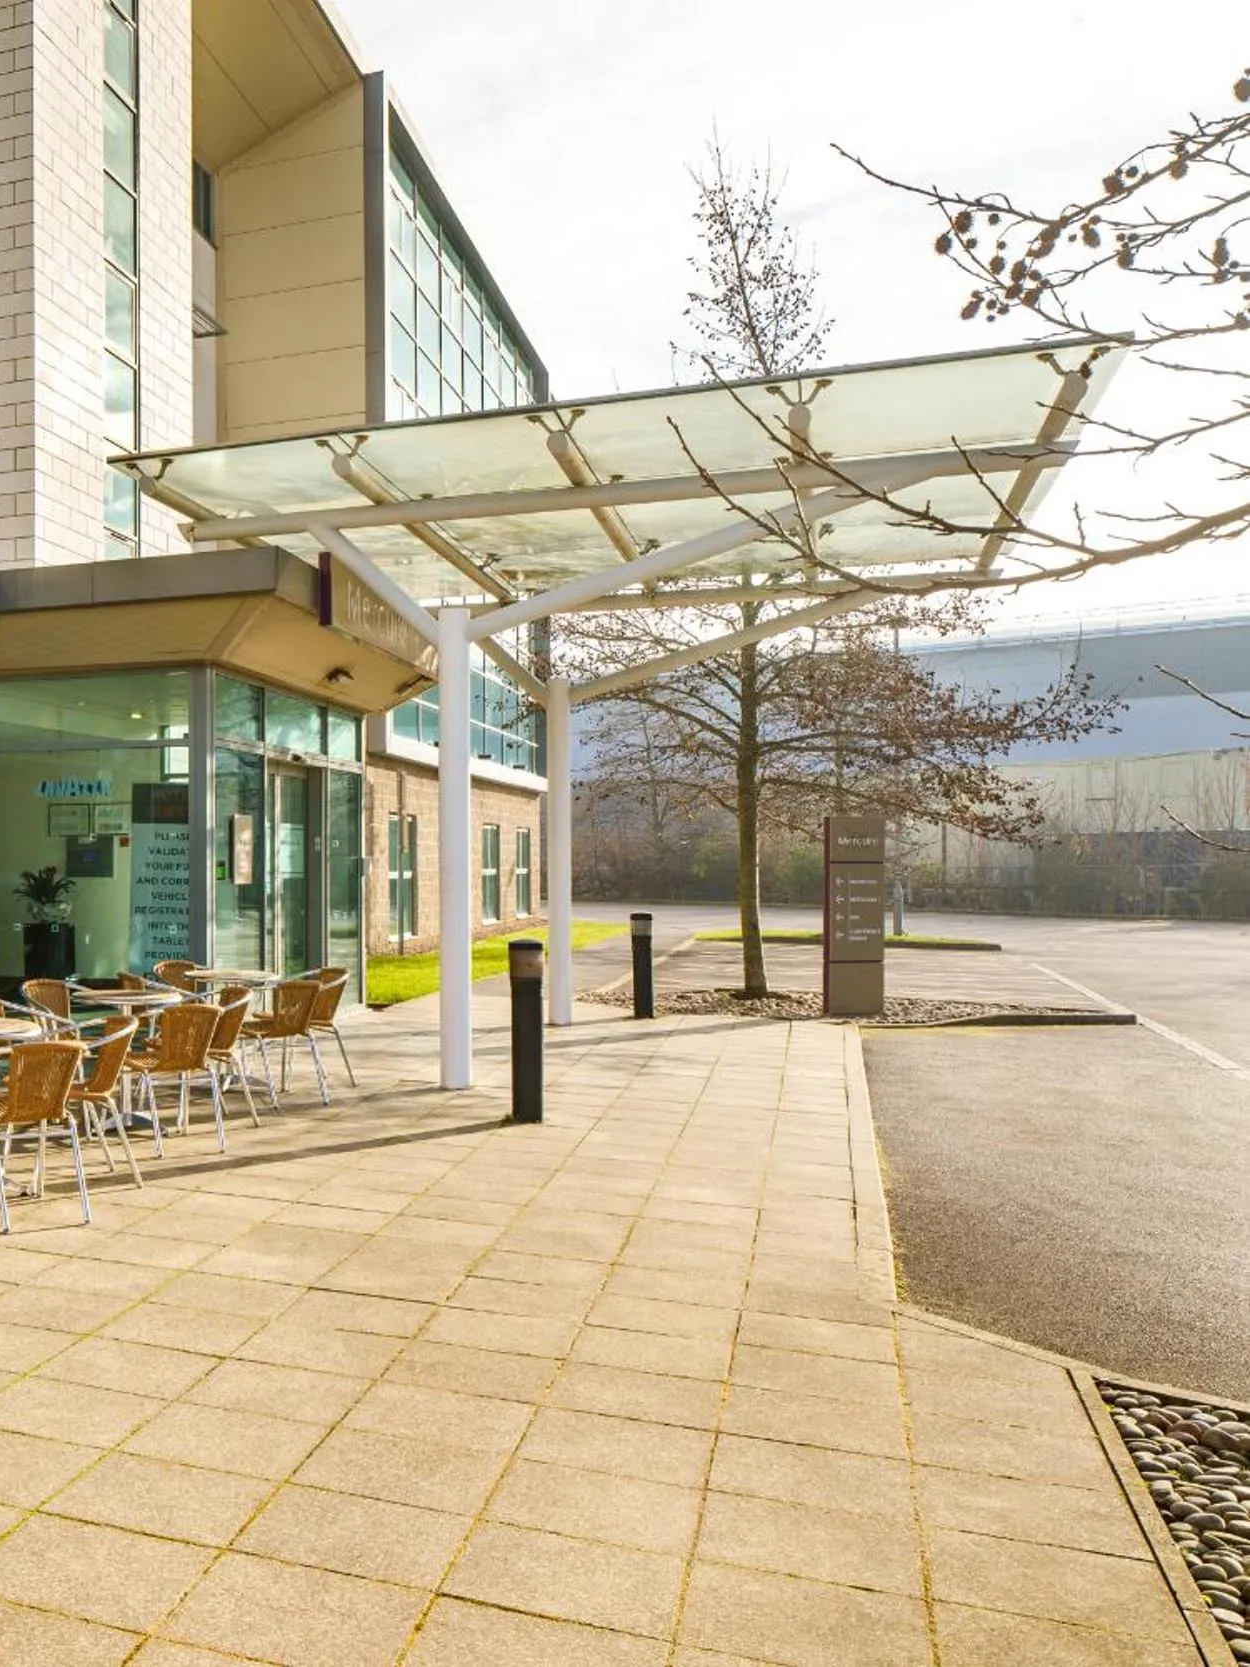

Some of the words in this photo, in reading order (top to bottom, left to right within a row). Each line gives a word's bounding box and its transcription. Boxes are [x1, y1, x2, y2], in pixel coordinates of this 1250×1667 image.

[147, 847, 190, 856] VALIDA
[176, 862, 190, 871] FU
[136, 876, 158, 885] AND
[161, 876, 190, 885] CORR
[151, 891, 190, 901] VEHICL
[134, 906, 190, 915] REGISTRAT
